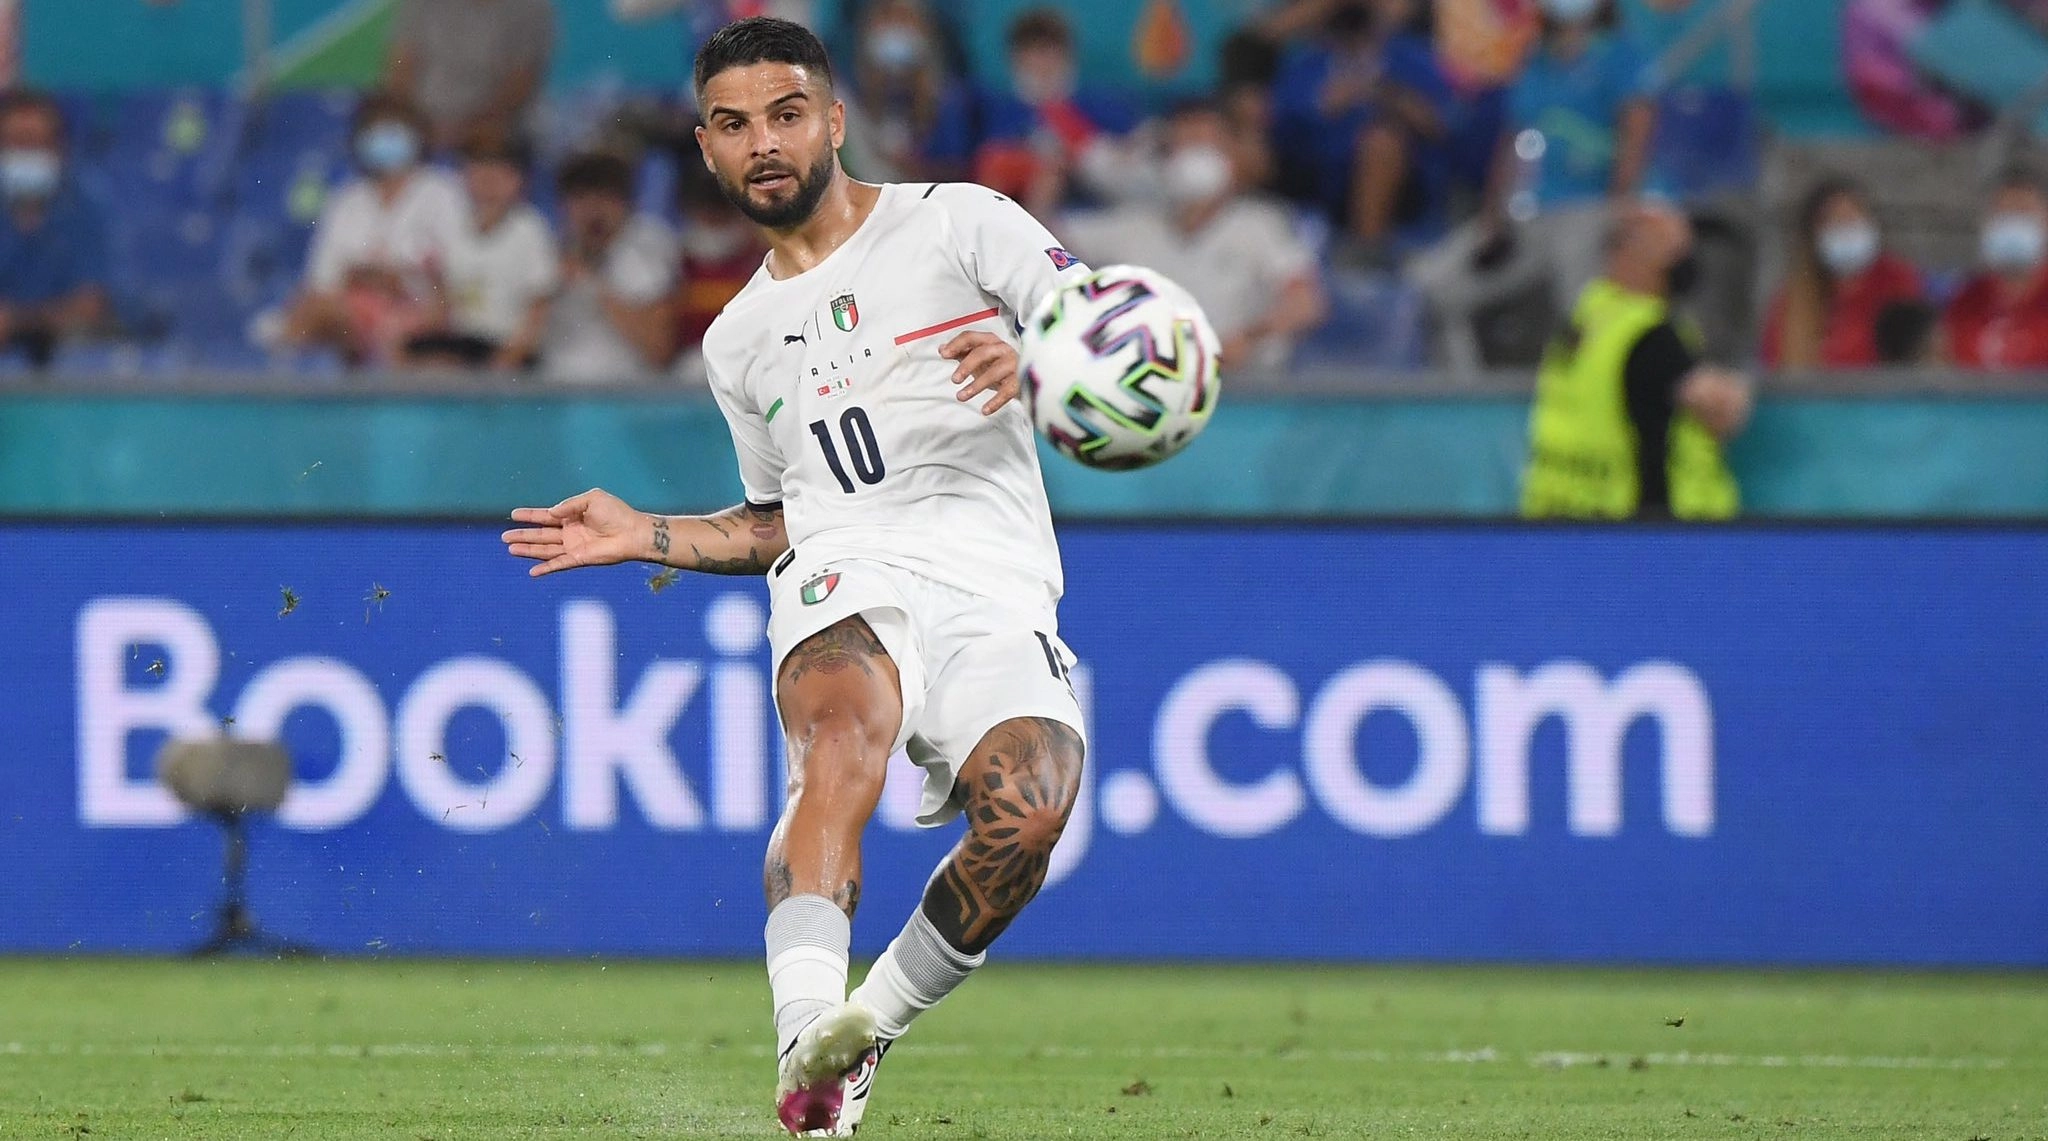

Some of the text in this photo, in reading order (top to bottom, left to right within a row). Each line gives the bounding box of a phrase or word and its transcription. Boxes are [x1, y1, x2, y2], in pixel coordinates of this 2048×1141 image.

[831, 295, 854, 308] ITALIA
[809, 406, 886, 494] 10
[75, 591, 1716, 886] Booki.com
